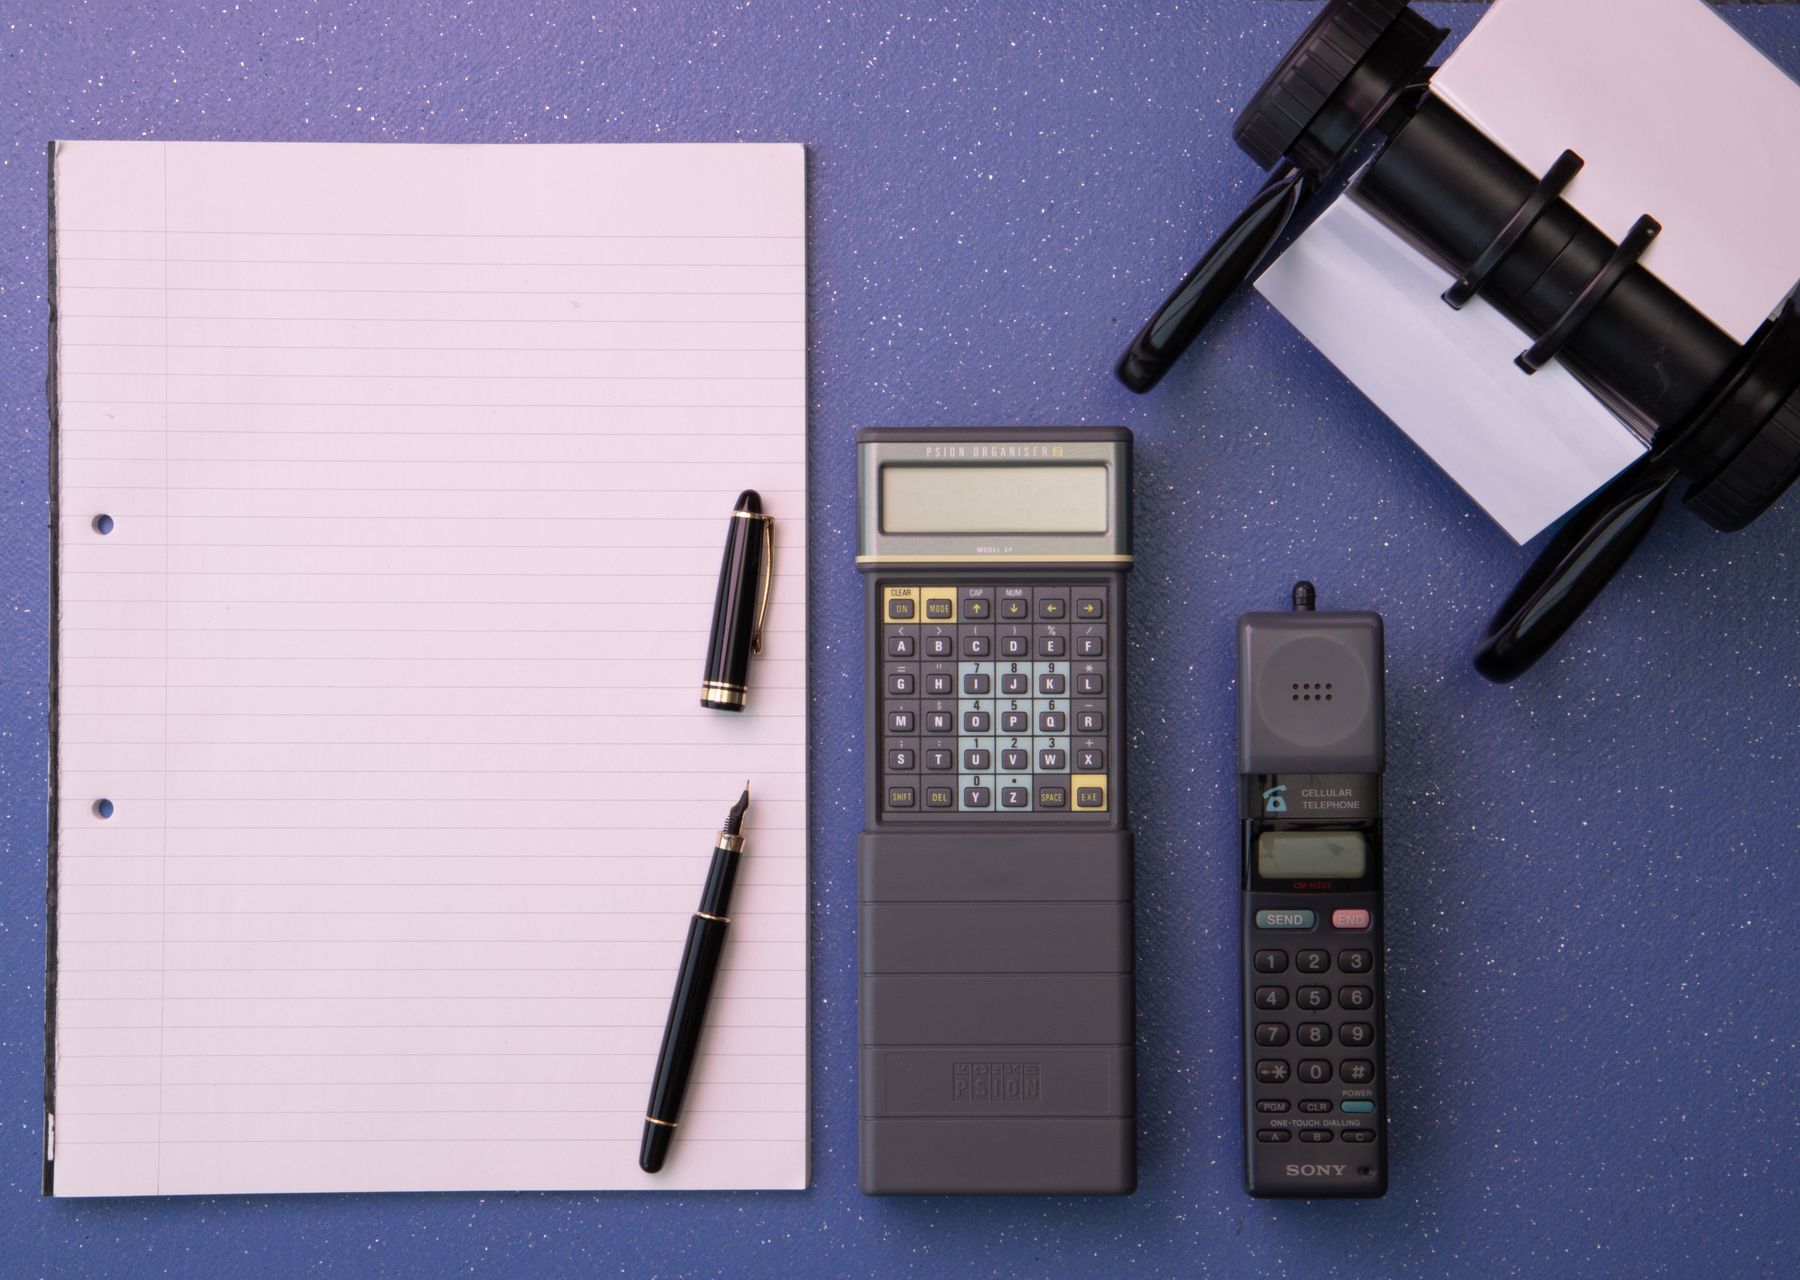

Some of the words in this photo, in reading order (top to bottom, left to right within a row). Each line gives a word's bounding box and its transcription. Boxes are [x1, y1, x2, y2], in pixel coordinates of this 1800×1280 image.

[926, 447, 965, 457] PSION
[973, 447, 1049, 457] ORGANISER
[896, 605, 908, 613] ON
[929, 605, 949, 613] MODE
[897, 641, 905, 651] A
[935, 641, 943, 651] B
[973, 641, 980, 651] C
[1010, 641, 1017, 651] D
[1047, 641, 1054, 651] E
[1085, 641, 1092, 651] F
[974, 663, 980, 673] 7
[1011, 663, 1017, 673] 8
[1049, 663, 1055, 673] 9
[897, 679, 905, 689] G
[935, 679, 942, 689] H
[974, 679, 978, 689] I
[1010, 679, 1017, 689] J
[1047, 679, 1054, 689] K
[1085, 679, 1091, 689] L
[974, 700, 980, 711] 4
[1011, 700, 1017, 711] 5
[1049, 700, 1055, 711] 6
[896, 717, 906, 727] M
[935, 717, 942, 727] N
[1010, 717, 1017, 727] P
[1047, 717, 1055, 727] Q
[1085, 717, 1092, 727] R
[974, 738, 978, 748] 1
[1011, 738, 1017, 748] 2
[1049, 738, 1055, 748] 3
[897, 754, 905, 765] S
[935, 754, 942, 765] T
[972, 754, 979, 765] U
[1009, 754, 1016, 765] V
[1045, 754, 1056, 765] W
[1085, 754, 1092, 765] X
[974, 776, 980, 786] 0
[893, 793, 912, 801] SHIFT
[932, 793, 947, 802] DEL
[972, 792, 979, 802] Y
[1010, 792, 1016, 802] Z
[1041, 793, 1062, 802] SPACE
[1082, 793, 1097, 801] EXE
[1301, 789, 1352, 797] CELLULAR
[1303, 801, 1360, 809] TELEPHONE
[1267, 914, 1303, 925] SEND
[1338, 914, 1364, 925] END
[1267, 954, 1274, 969] 1
[1309, 954, 1319, 969] 2
[1351, 954, 1362, 969] 3
[1267, 991, 1276, 1005] 4
[1310, 991, 1320, 1005] 5
[1351, 991, 1362, 1005] 6
[1268, 1027, 1278, 1041] 7
[1310, 1027, 1321, 1041] 8
[1352, 1027, 1363, 1041] 9
[1310, 1065, 1321, 1079] 0
[1352, 1065, 1365, 1079] #
[955, 1079, 1040, 1097] PSION
[1271, 1133, 1279, 1141] A
[1314, 1133, 1321, 1141] B
[1356, 1133, 1363, 1141] C
[1286, 1165, 1346, 1176] SONY
